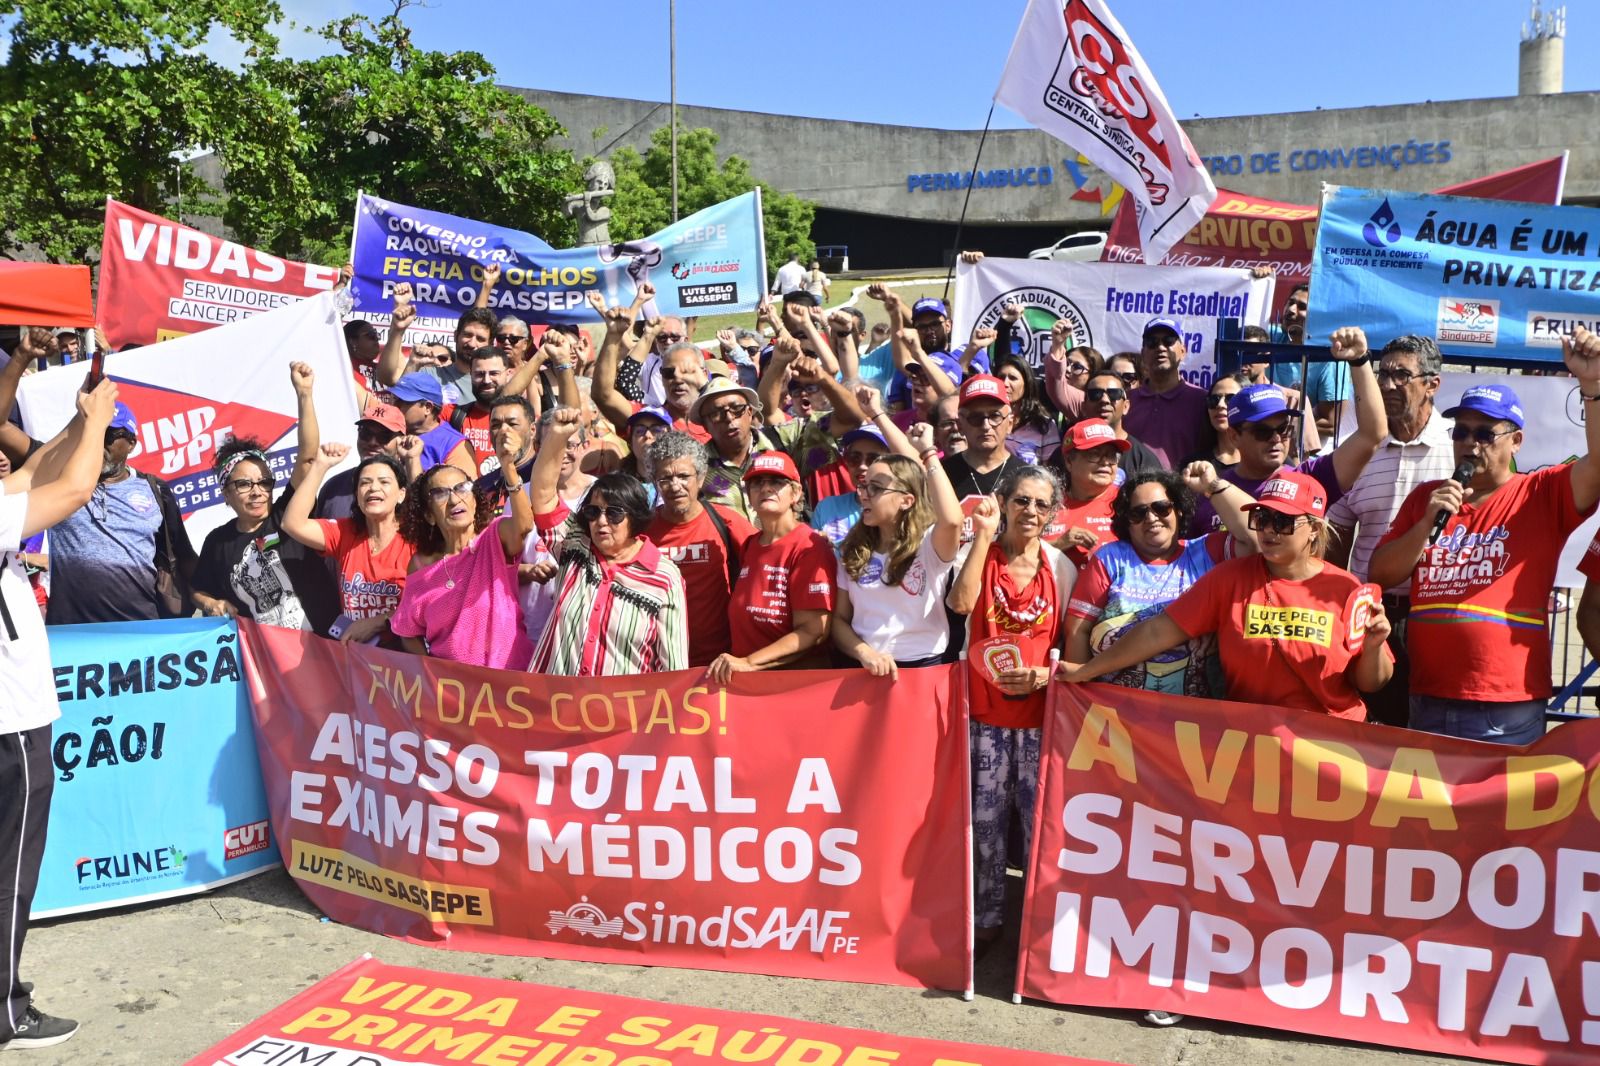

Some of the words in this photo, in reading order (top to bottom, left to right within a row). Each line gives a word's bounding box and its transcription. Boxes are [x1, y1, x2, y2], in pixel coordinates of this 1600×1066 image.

[1050, 91, 1105, 132] CENTRAL
[907, 166, 1053, 193] PERNAMBUCO
[1204, 152, 1245, 176] TRO
[1250, 153, 1280, 174] DE
[1290, 140, 1453, 171] CONVENÇÕES
[388, 216, 487, 248] GOVERNO
[1415, 210, 1497, 249] ÁGUA
[1510, 219, 1533, 251] É
[1541, 229, 1589, 256] UM
[118, 218, 287, 283] VIDAS
[386, 235, 462, 256] RAQUEL
[467, 248, 520, 263] LYRA
[1107, 245, 1145, 263] DIGA
[1325, 247, 1338, 255] EM
[1340, 248, 1372, 257] DEFESA
[1374, 249, 1387, 258] DA
[1389, 250, 1429, 259] COMPESA
[1333, 256, 1369, 267] PÚBLICA
[1371, 259, 1377, 267] E
[1379, 260, 1424, 270] EFICIENTE
[383, 257, 464, 281] FECHA
[470, 264, 500, 285] O
[506, 267, 598, 286] OLHOS
[183, 281, 290, 310] SERVIDORES
[382, 281, 451, 304] PRA
[457, 286, 477, 306] O
[682, 287, 706, 296] LUTE
[708, 285, 733, 294] PELO
[685, 293, 731, 304] SASSEPE!
[1000, 292, 1057, 309] ESTADUAL
[1106, 287, 1164, 314] Frente
[1167, 289, 1250, 318] Estadual
[170, 300, 237, 322] CANCER
[1440, 330, 1493, 342] Sindurb-PE
[191, 491, 211, 504] DE
[769, 599, 787, 608] pela
[1251, 609, 1287, 622] LUTE
[1291, 611, 1328, 626] PELO
[1249, 623, 1326, 642] SASSEPE
[368, 664, 423, 719] FIM
[437, 678, 534, 730] DAS
[550, 687, 728, 735] COTAS!
[53, 715, 166, 782] ÇÃO!
[310, 712, 500, 799] ACESSO
[524, 750, 757, 814] TOTAL
[786, 757, 842, 814] A
[1066, 702, 1138, 784] A
[1174, 720, 1459, 831] VIDA
[1504, 754, 1600, 831] D
[225, 822, 269, 850] CUT
[290, 770, 500, 866] EXAMES
[527, 813, 862, 887] MÉDICOS
[227, 841, 268, 858] PERNAMBUCO
[76, 848, 170, 885] FRUNE
[298, 851, 344, 882] LUTE
[347, 864, 384, 893] PELO
[387, 877, 483, 917] SASSEPE
[622, 900, 850, 953] SindSAAF
[832, 936, 860, 955] PE
[339, 976, 520, 1027] VIDA
[535, 1005, 602, 1038] E
[605, 1015, 901, 1066] SAÚDE
